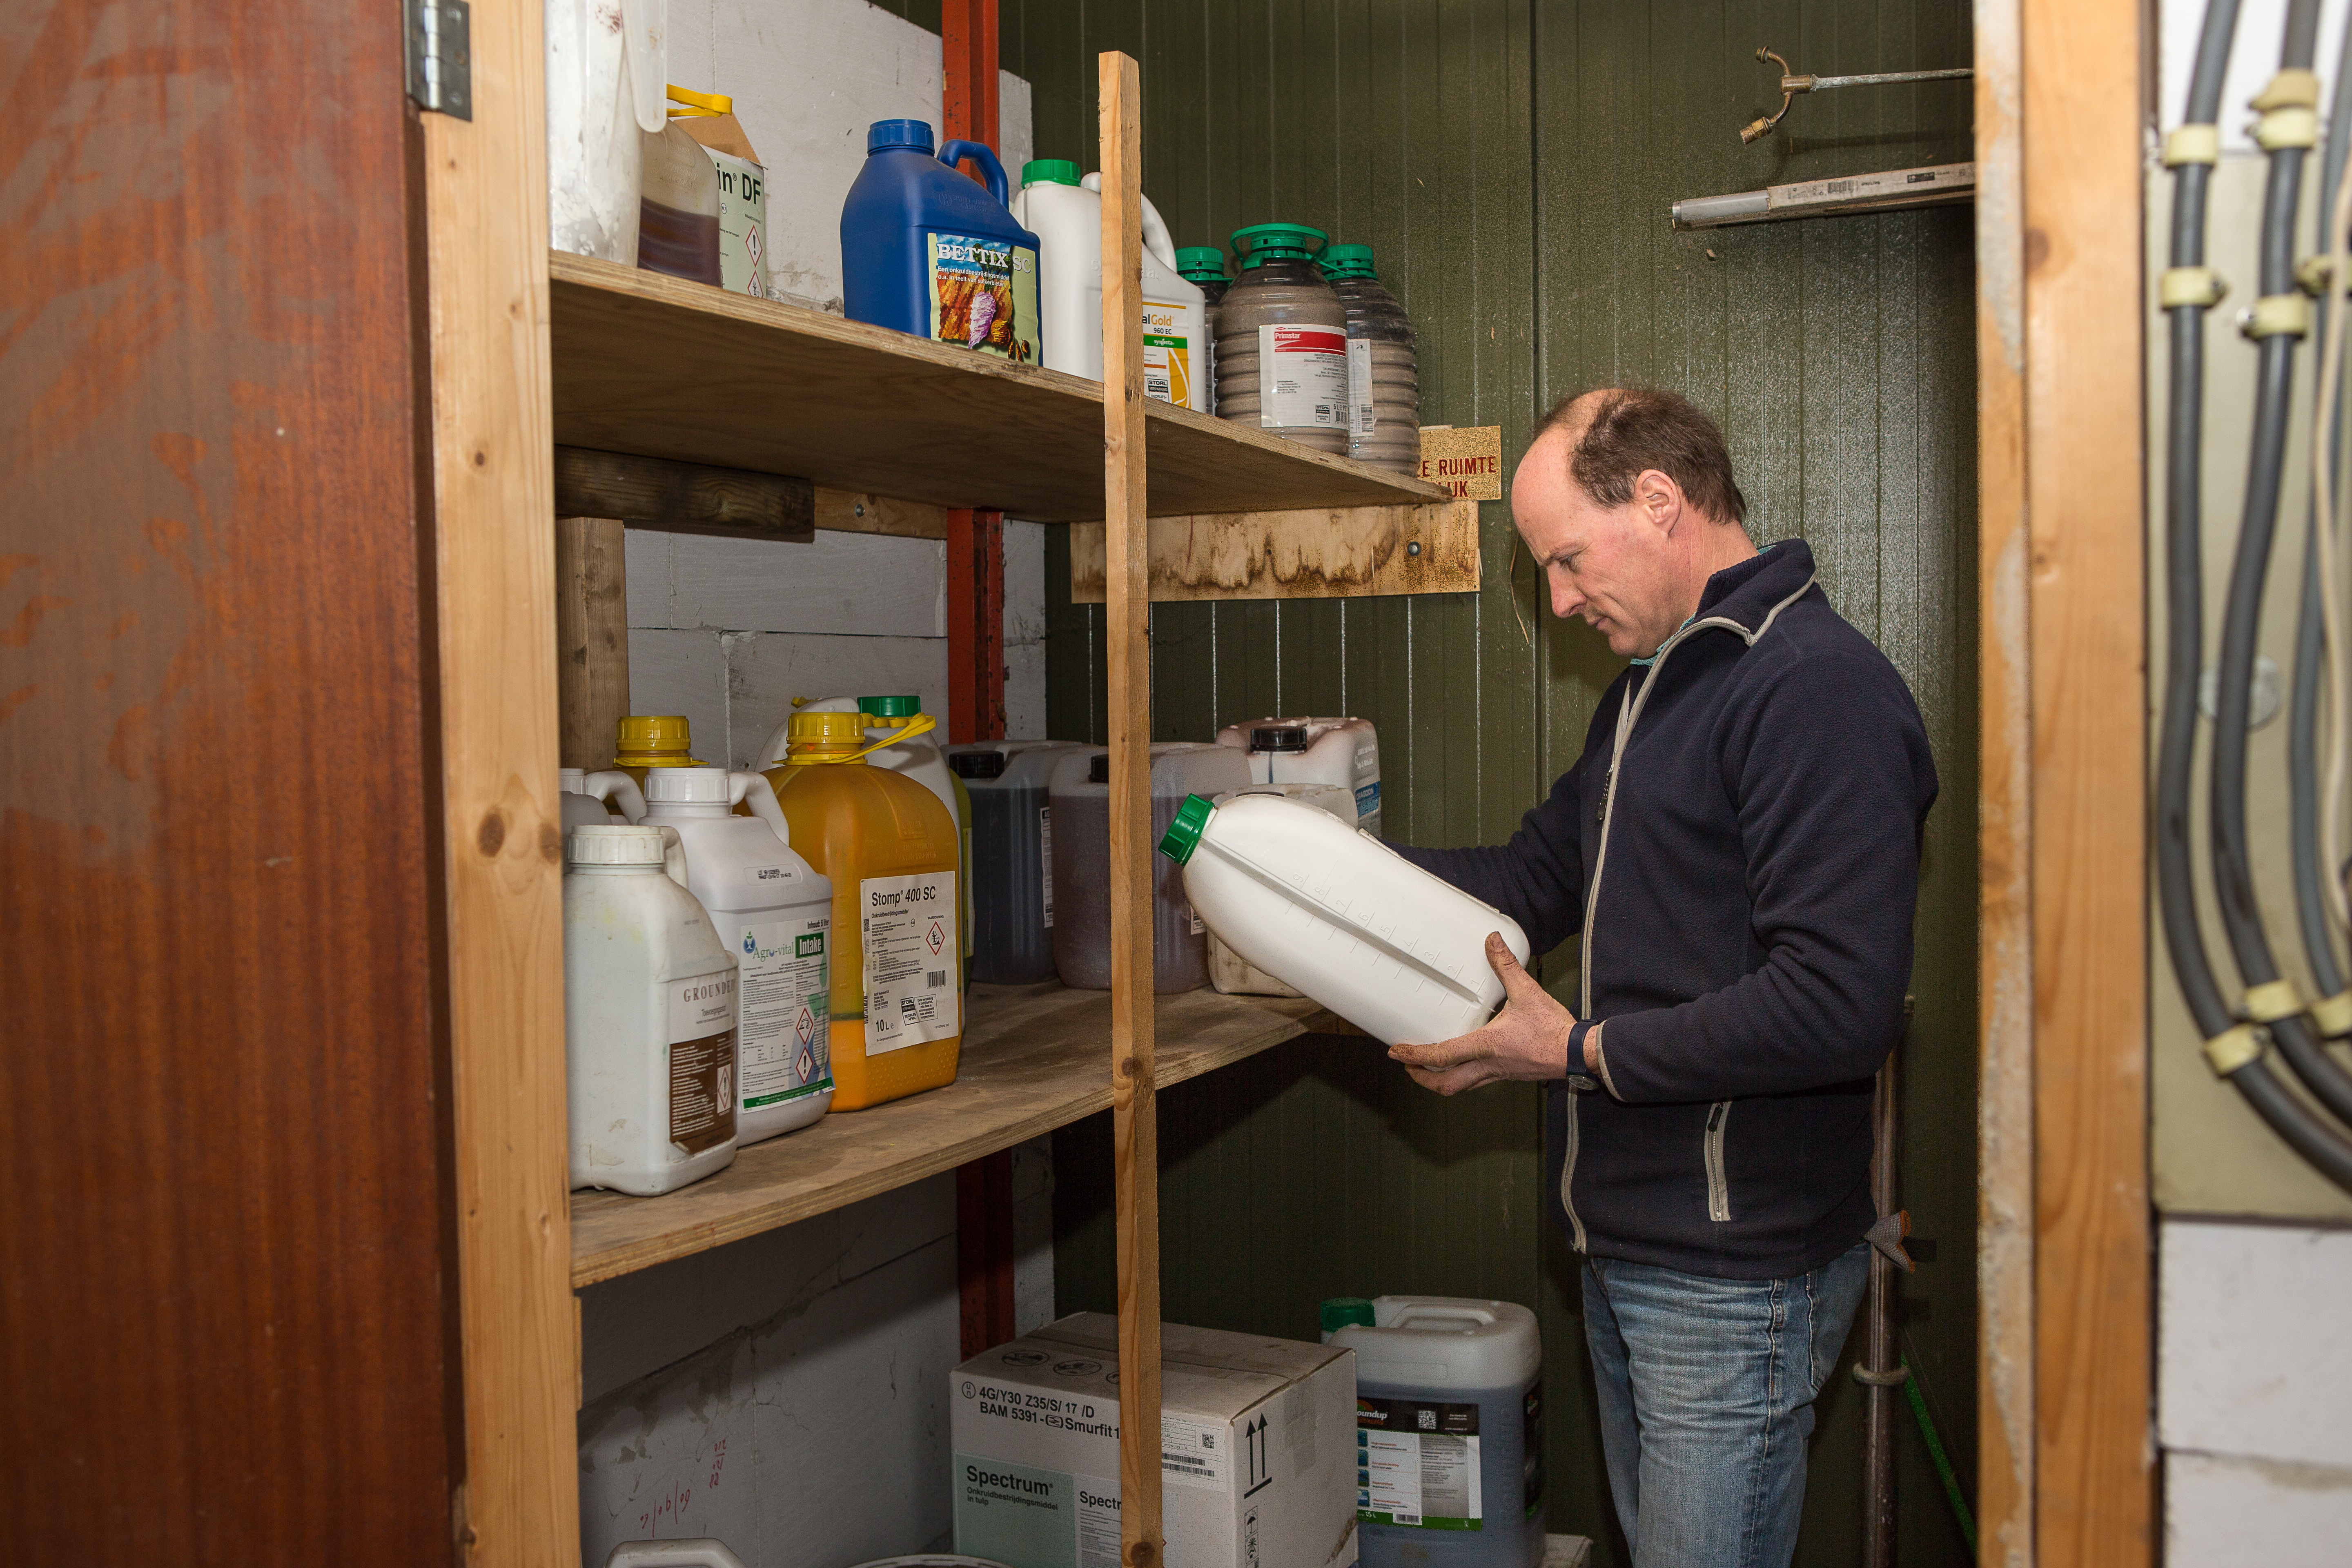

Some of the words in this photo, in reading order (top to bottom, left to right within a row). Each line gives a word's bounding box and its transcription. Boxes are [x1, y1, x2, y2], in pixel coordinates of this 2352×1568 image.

[742, 172, 761, 204] DF
[937, 243, 1008, 268] BETTIX
[1013, 255, 1031, 273] SC
[949, 267, 1010, 281] onkruidbestrijdingsmiddel
[978, 278, 1005, 287] suikerbieten
[1439, 456, 1497, 476] RUIMTE
[905, 888, 921, 902] 400
[923, 886, 936, 900] SC
[871, 909, 909, 918] Onkruidbestrijdingsmiddel
[799, 937, 822, 955] Intake
[876, 1019, 884, 1032] 10
[886, 1021, 889, 1030] L
[979, 1386, 1021, 1405] 4G/Y30
[1026, 1394, 1062, 1412] Z35/S/
[1065, 1402, 1077, 1414] 17
[1081, 1405, 1095, 1418] /D
[980, 1401, 1008, 1418] BAM
[1065, 1417, 1113, 1438] Smurfit
[967, 1487, 1058, 1510] Onkruidbestrijdingsmiddel
[975, 1496, 989, 1506] tulp
